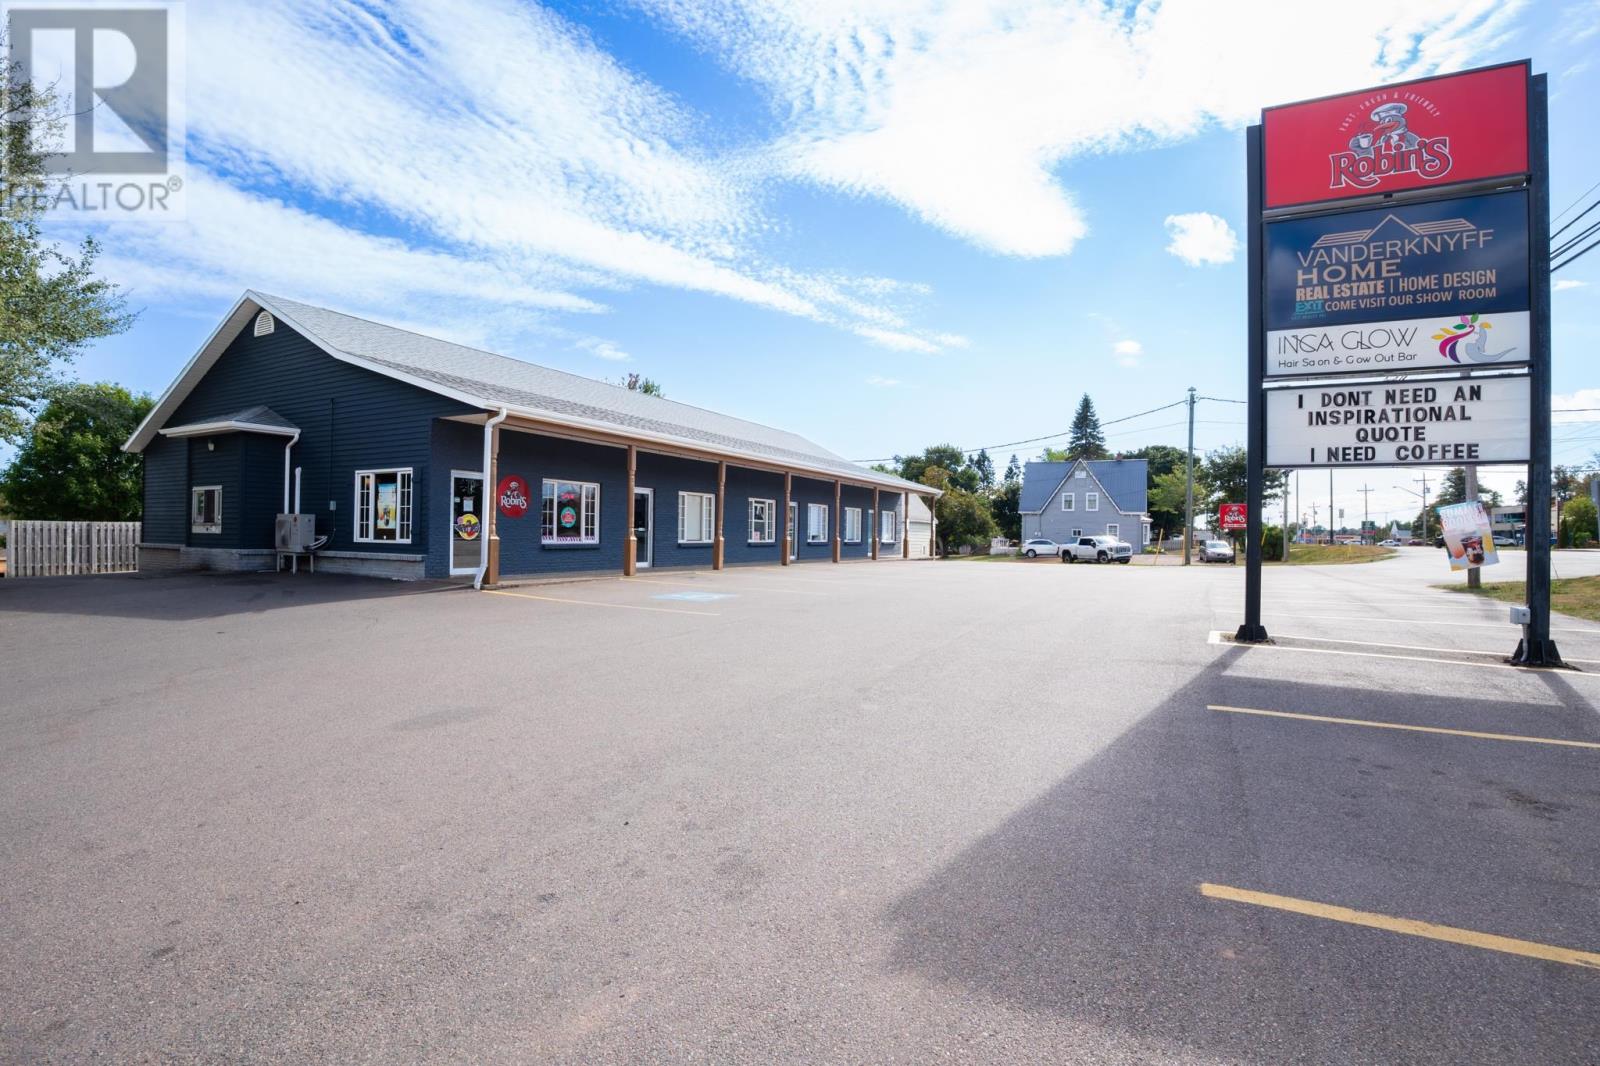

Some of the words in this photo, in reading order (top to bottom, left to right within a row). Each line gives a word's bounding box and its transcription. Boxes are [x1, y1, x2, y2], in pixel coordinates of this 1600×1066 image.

[1296, 229, 1494, 268] VANDERKNYFF
[1295, 283, 1330, 301] REAL
[1332, 279, 1385, 299] ESTATE
[1399, 274, 1439, 293] HOME
[1443, 269, 1497, 288] DESIGN
[1296, 259, 1402, 287] HOME
[1325, 299, 1357, 312] COME
[1359, 297, 1386, 309] VISIT
[1388, 294, 1413, 307] OUR
[1415, 291, 1453, 305] SHOW
[1458, 287, 1497, 300] ROOM
[1341, 327, 1418, 350] GLOW
[1278, 359, 1299, 368] Hair
[1302, 357, 1330, 367] Saon
[1333, 356, 1343, 365] &
[1345, 354, 1371, 364] Gow
[1374, 353, 1394, 363] Out
[1398, 352, 1418, 361] Bar
[1298, 394, 1303, 409] I
[1321, 391, 1373, 408] DONT
[1385, 387, 1437, 405] NEED
[1454, 384, 1482, 401] AN
[1308, 405, 1472, 426] INSPIRATIONAL
[1355, 426, 1426, 443] QUOTE
[1310, 447, 1315, 462] I
[1327, 446, 1376, 463] NEED
[1395, 443, 1480, 461] COFFEE
